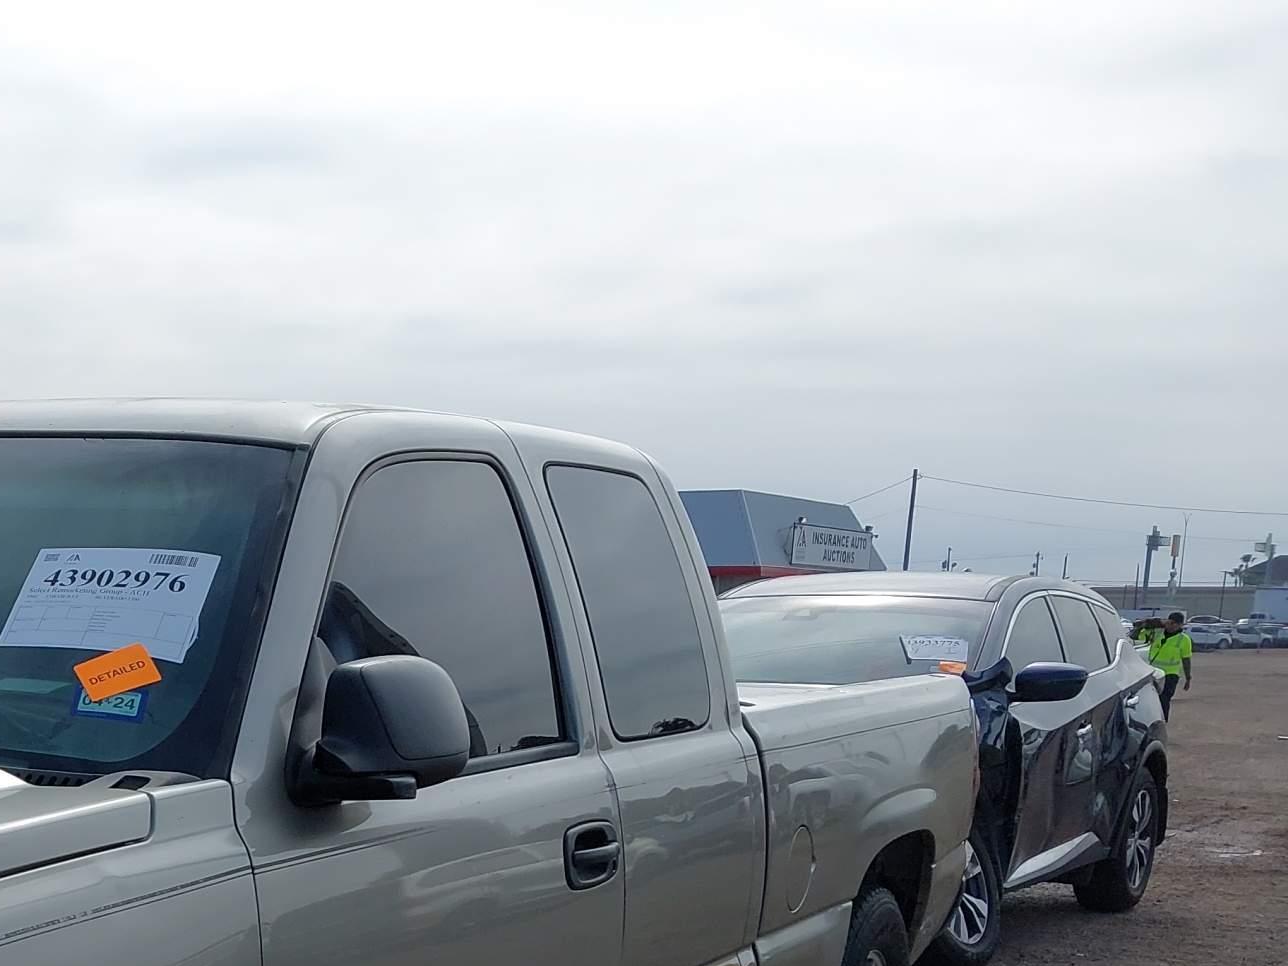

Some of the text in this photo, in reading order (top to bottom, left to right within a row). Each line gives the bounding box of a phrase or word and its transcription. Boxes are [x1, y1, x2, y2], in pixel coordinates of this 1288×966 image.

[812, 531, 850, 548] INSURANCE
[850, 536, 867, 550] AUTO
[822, 549, 855, 563] AUCTIONS
[43, 568, 191, 593] 43902976
[88, 660, 146, 686] DETAILED
